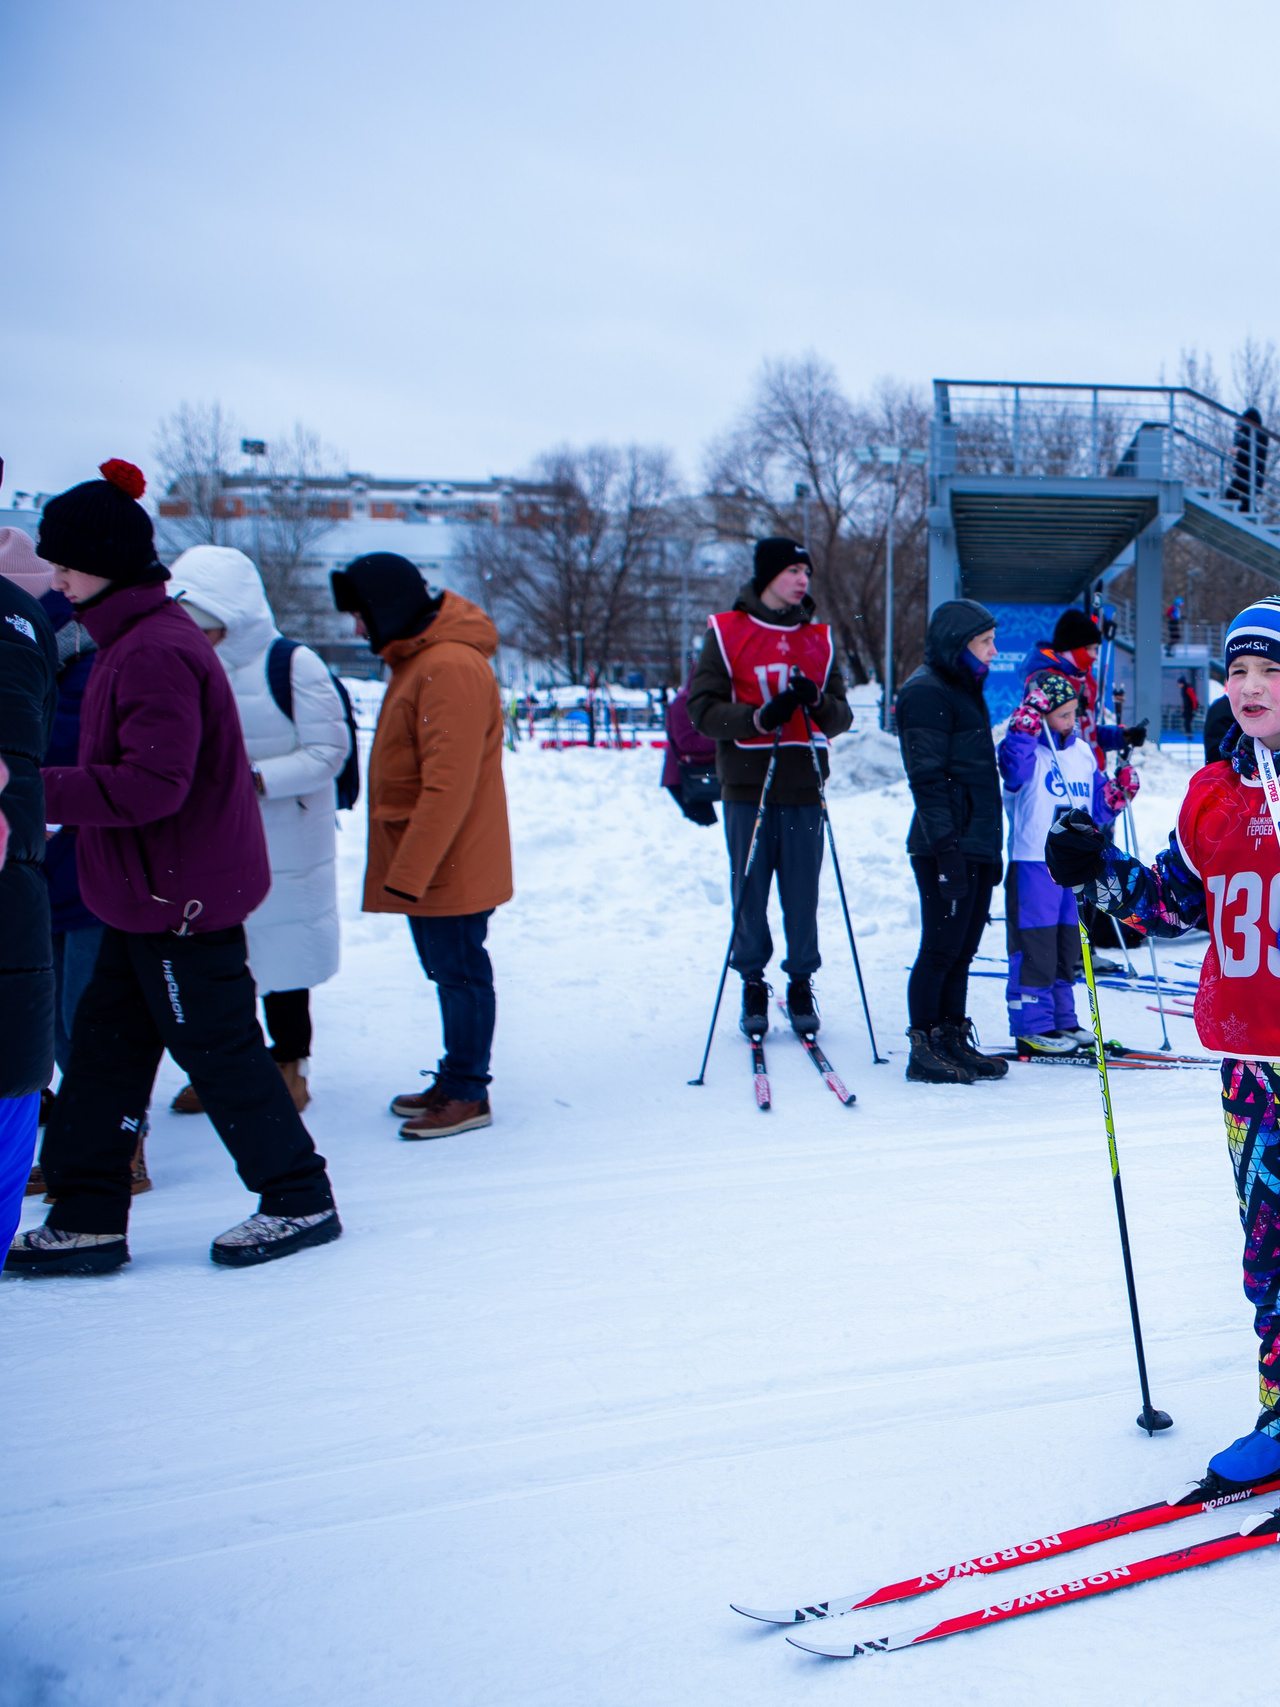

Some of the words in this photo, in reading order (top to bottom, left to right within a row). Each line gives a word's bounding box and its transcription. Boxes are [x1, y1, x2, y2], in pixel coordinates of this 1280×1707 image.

[754, 663, 806, 701] 17
[1267, 780, 1279, 802] ГЕРОЕВ
[1246, 825, 1274, 836] ГЕРОЕВ
[162, 960, 186, 1024] NORDSKI
[1030, 1055, 1091, 1065] ROSSIGNOL
[1201, 1489, 1253, 1510] NORDWAY
[916, 1534, 1064, 1588] NORDWAY
[981, 1566, 1131, 1619] NORDWAY
